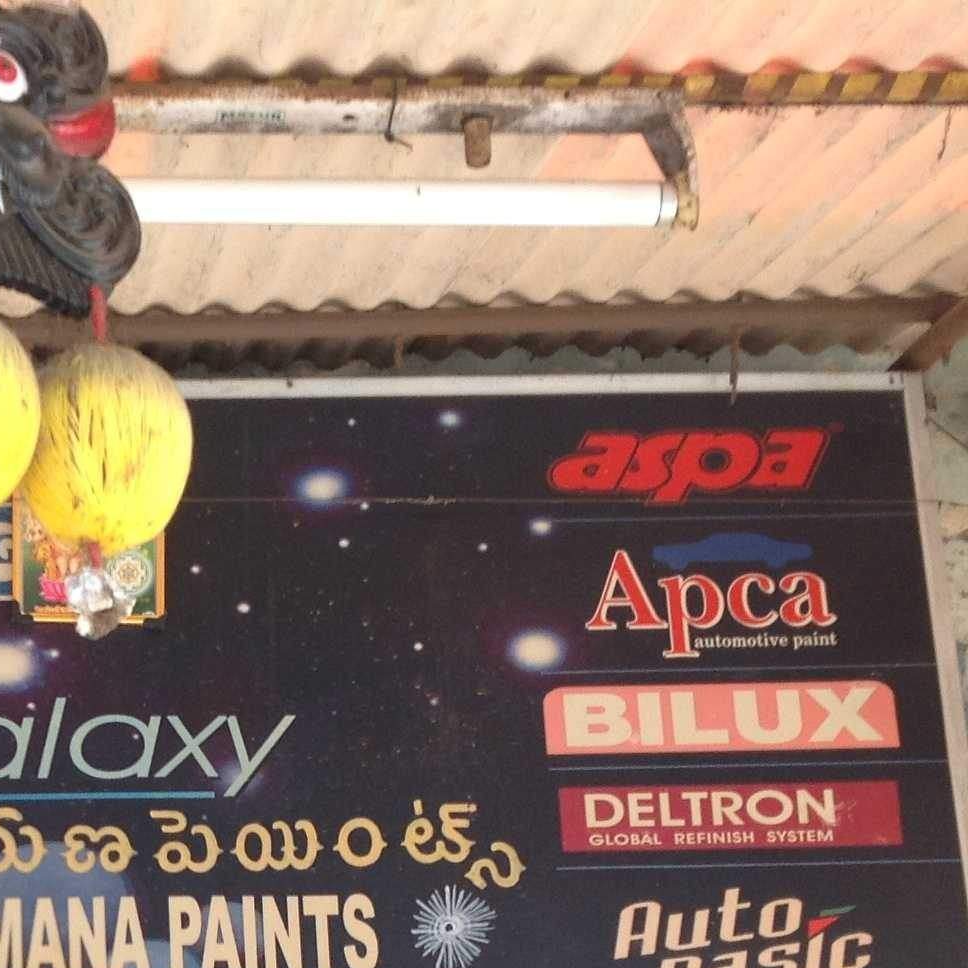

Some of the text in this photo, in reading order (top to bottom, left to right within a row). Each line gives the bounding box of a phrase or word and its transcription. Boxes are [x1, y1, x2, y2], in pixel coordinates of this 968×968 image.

[548, 427, 830, 507] aspa
[584, 549, 840, 659] Apca
[693, 632, 838, 650] automotive paint
[560, 686, 884, 750] BILUX
[583, 788, 838, 829] DELTRON
[588, 830, 834, 847] GLOBAL REFINISH SYSTEM
[613, 886, 803, 962] Auto
